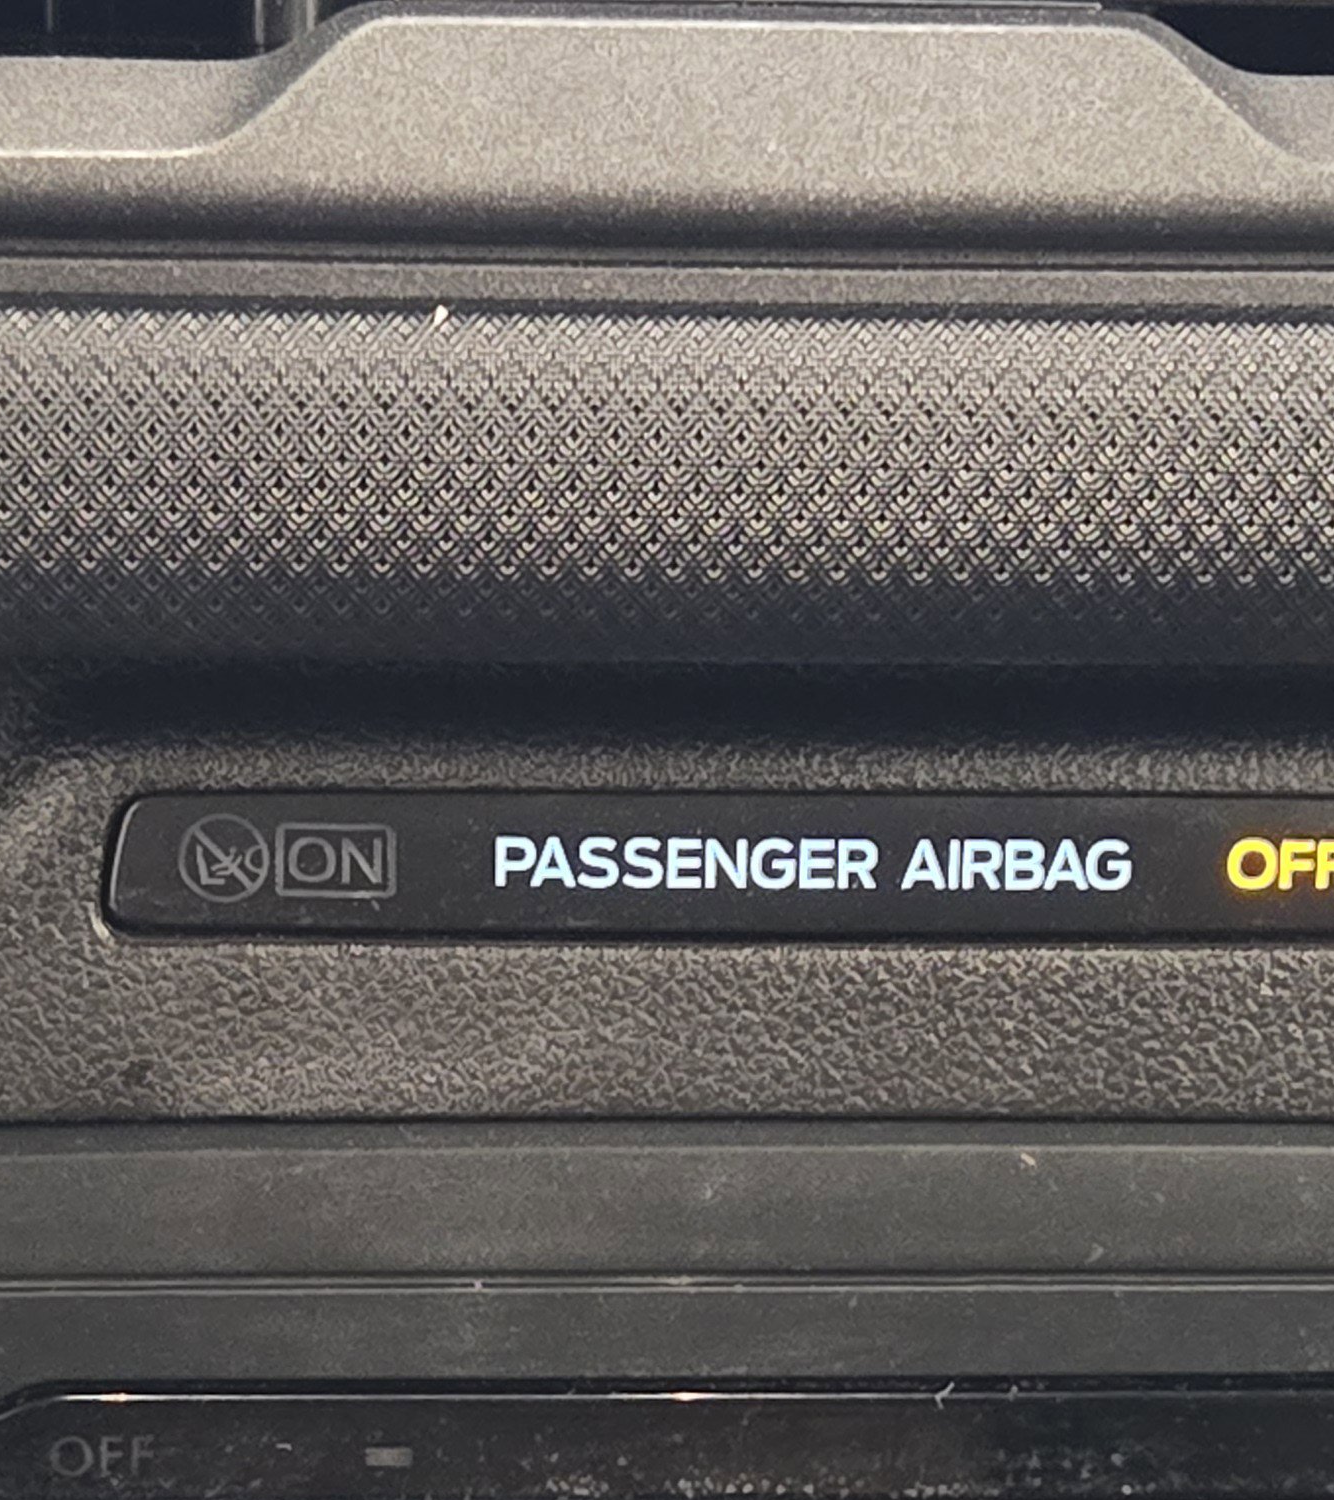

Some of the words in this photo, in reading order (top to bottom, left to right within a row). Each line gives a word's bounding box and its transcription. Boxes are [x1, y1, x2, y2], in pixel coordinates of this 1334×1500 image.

[287, 836, 384, 885] ON
[494, 836, 879, 890] PASSENGER
[900, 838, 1133, 891] AIRBAG
[49, 1434, 156, 1478] OFF
